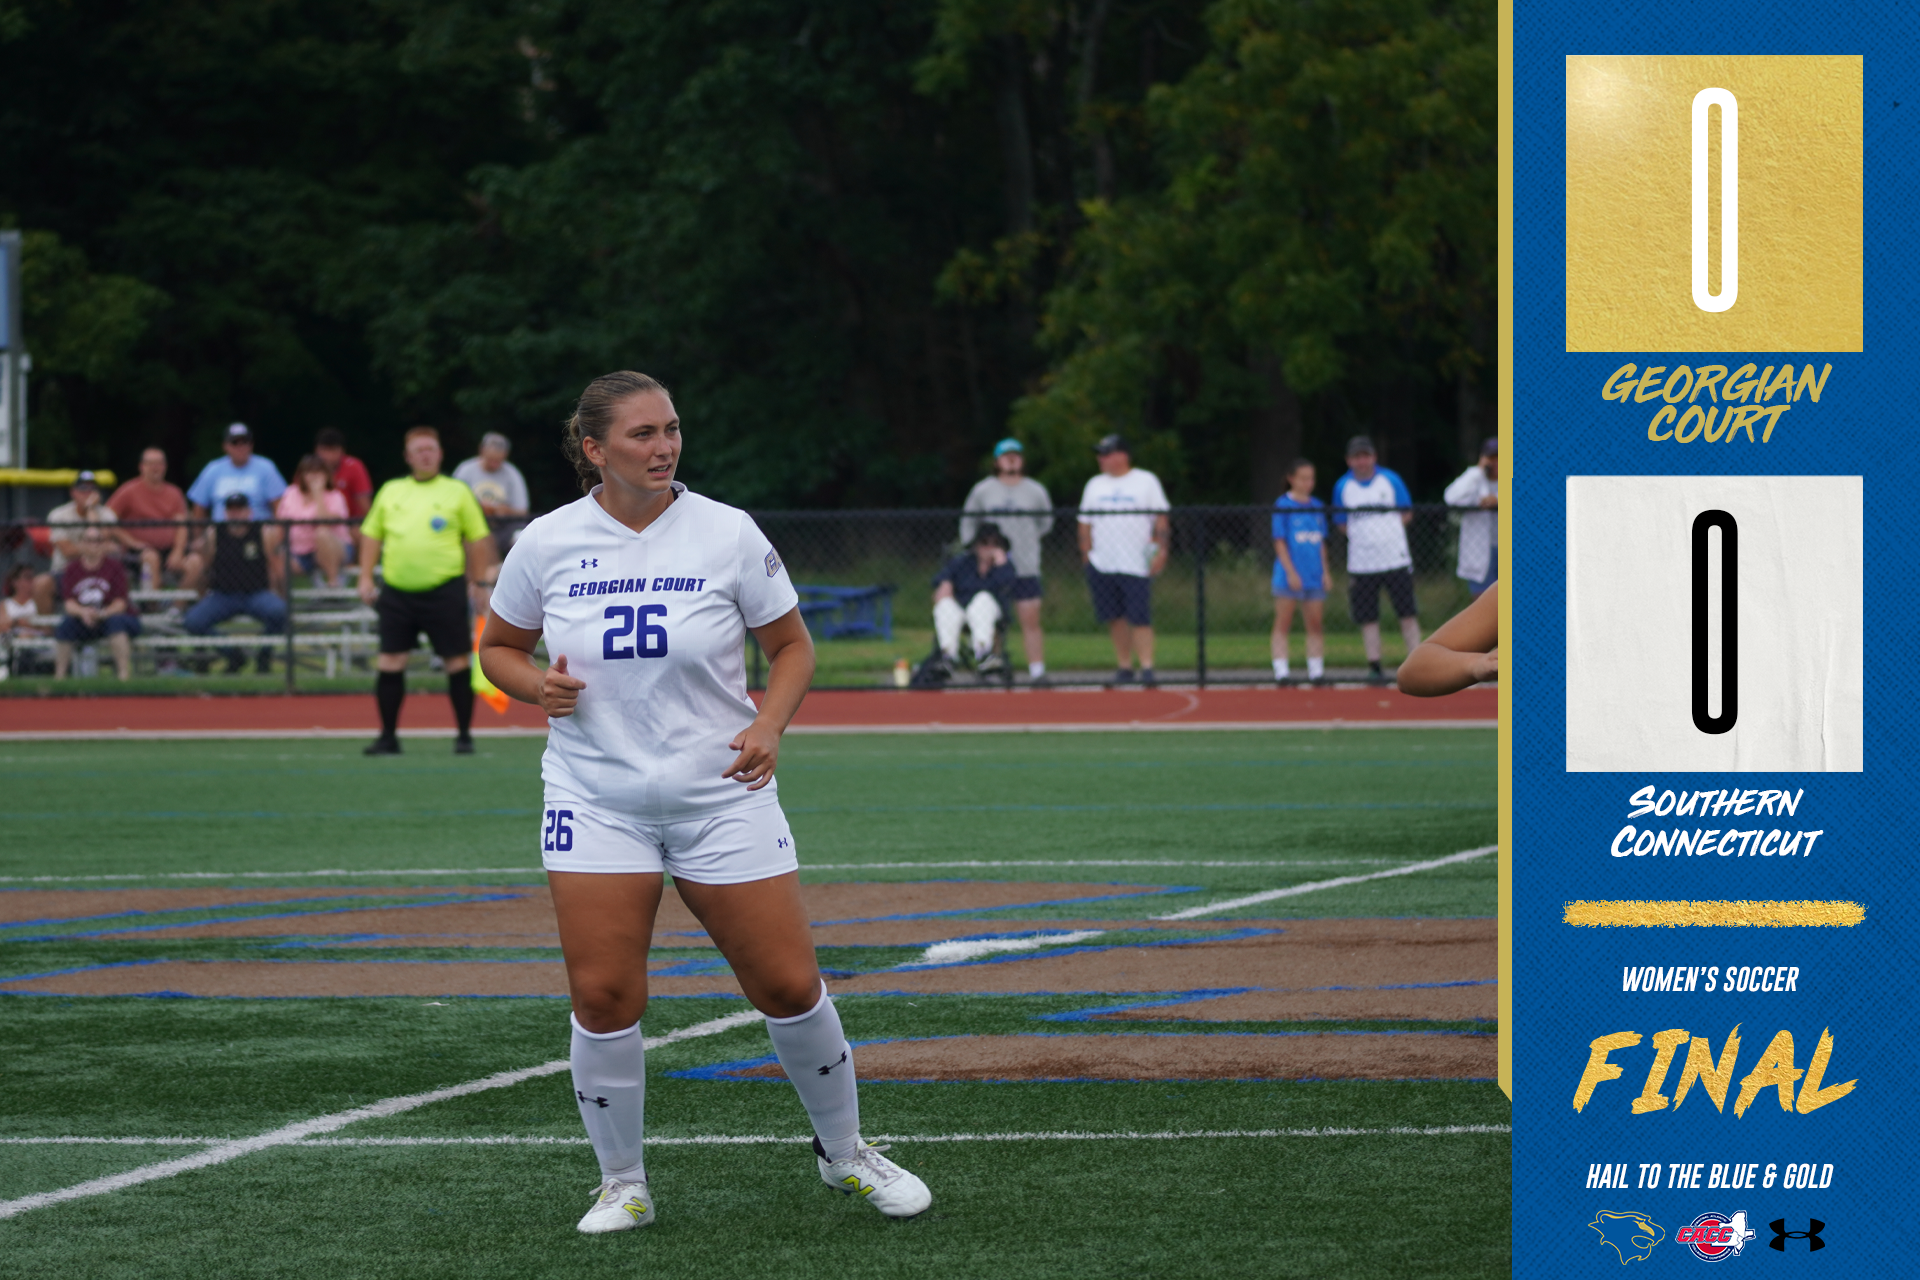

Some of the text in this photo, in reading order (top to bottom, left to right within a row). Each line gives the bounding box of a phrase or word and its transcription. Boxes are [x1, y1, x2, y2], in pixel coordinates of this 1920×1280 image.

[569, 577, 706, 597] GEORGIAN COURT
[603, 604, 668, 660] 26
[545, 809, 574, 851] 26
